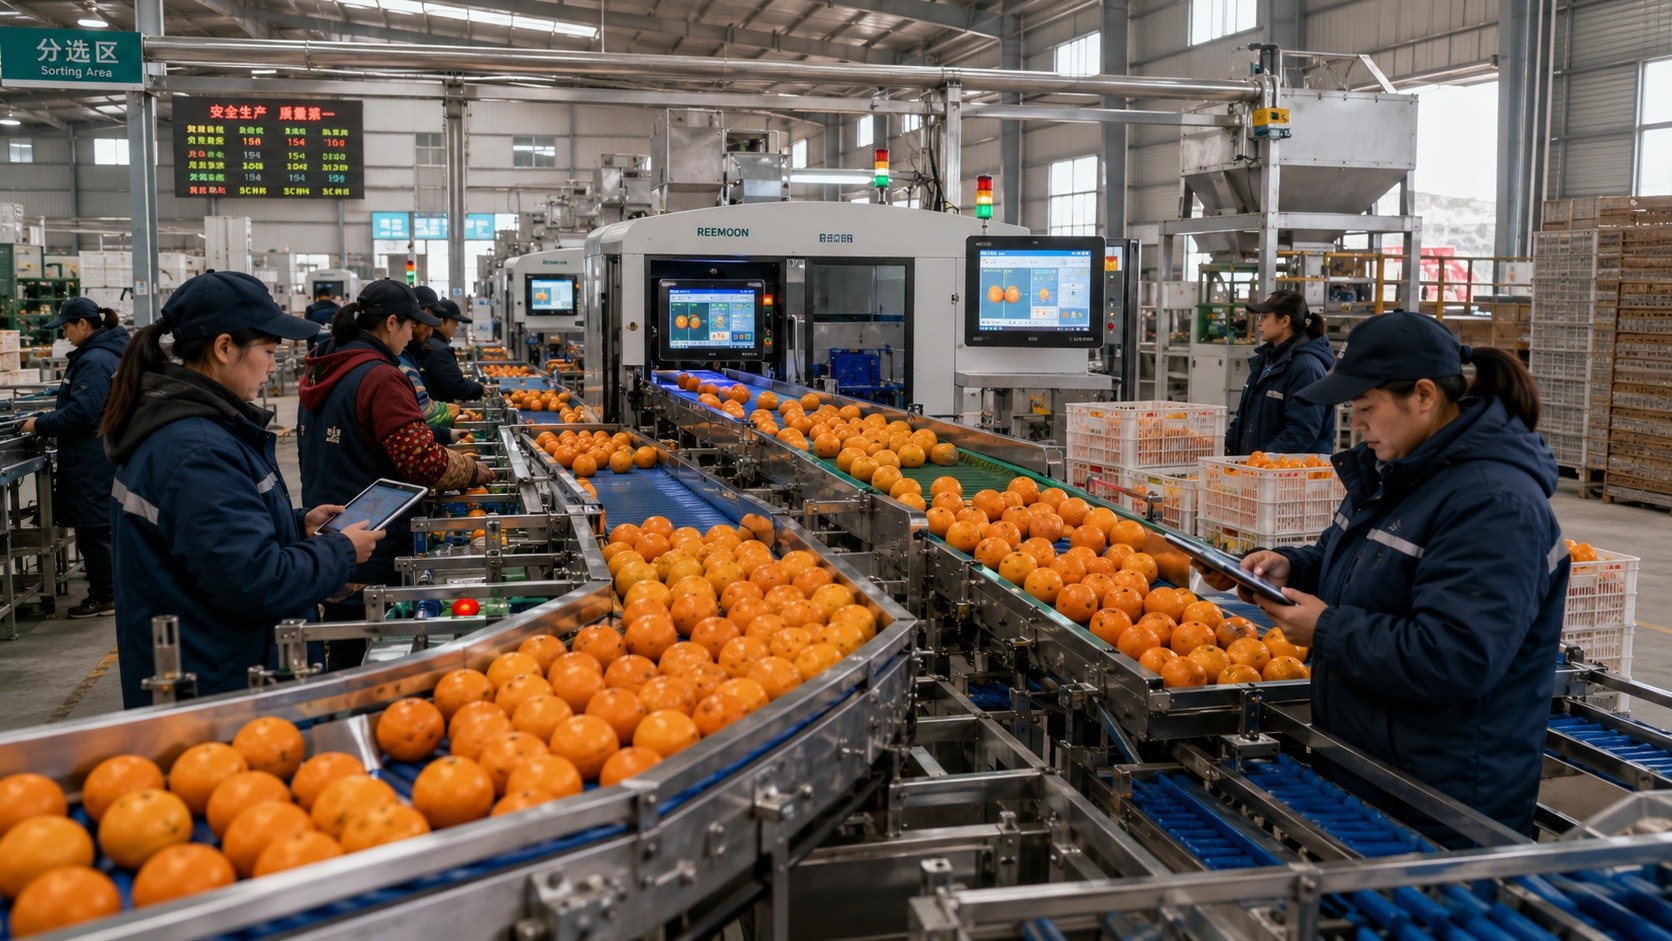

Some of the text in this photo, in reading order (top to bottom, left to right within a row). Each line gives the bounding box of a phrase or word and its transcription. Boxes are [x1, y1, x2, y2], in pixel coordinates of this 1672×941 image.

[36, 38, 119, 63] 分选区
[41, 65, 112, 78] Sorting Area
[210, 104, 267, 119] 安全生产
[697, 227, 749, 237] REEMOON
